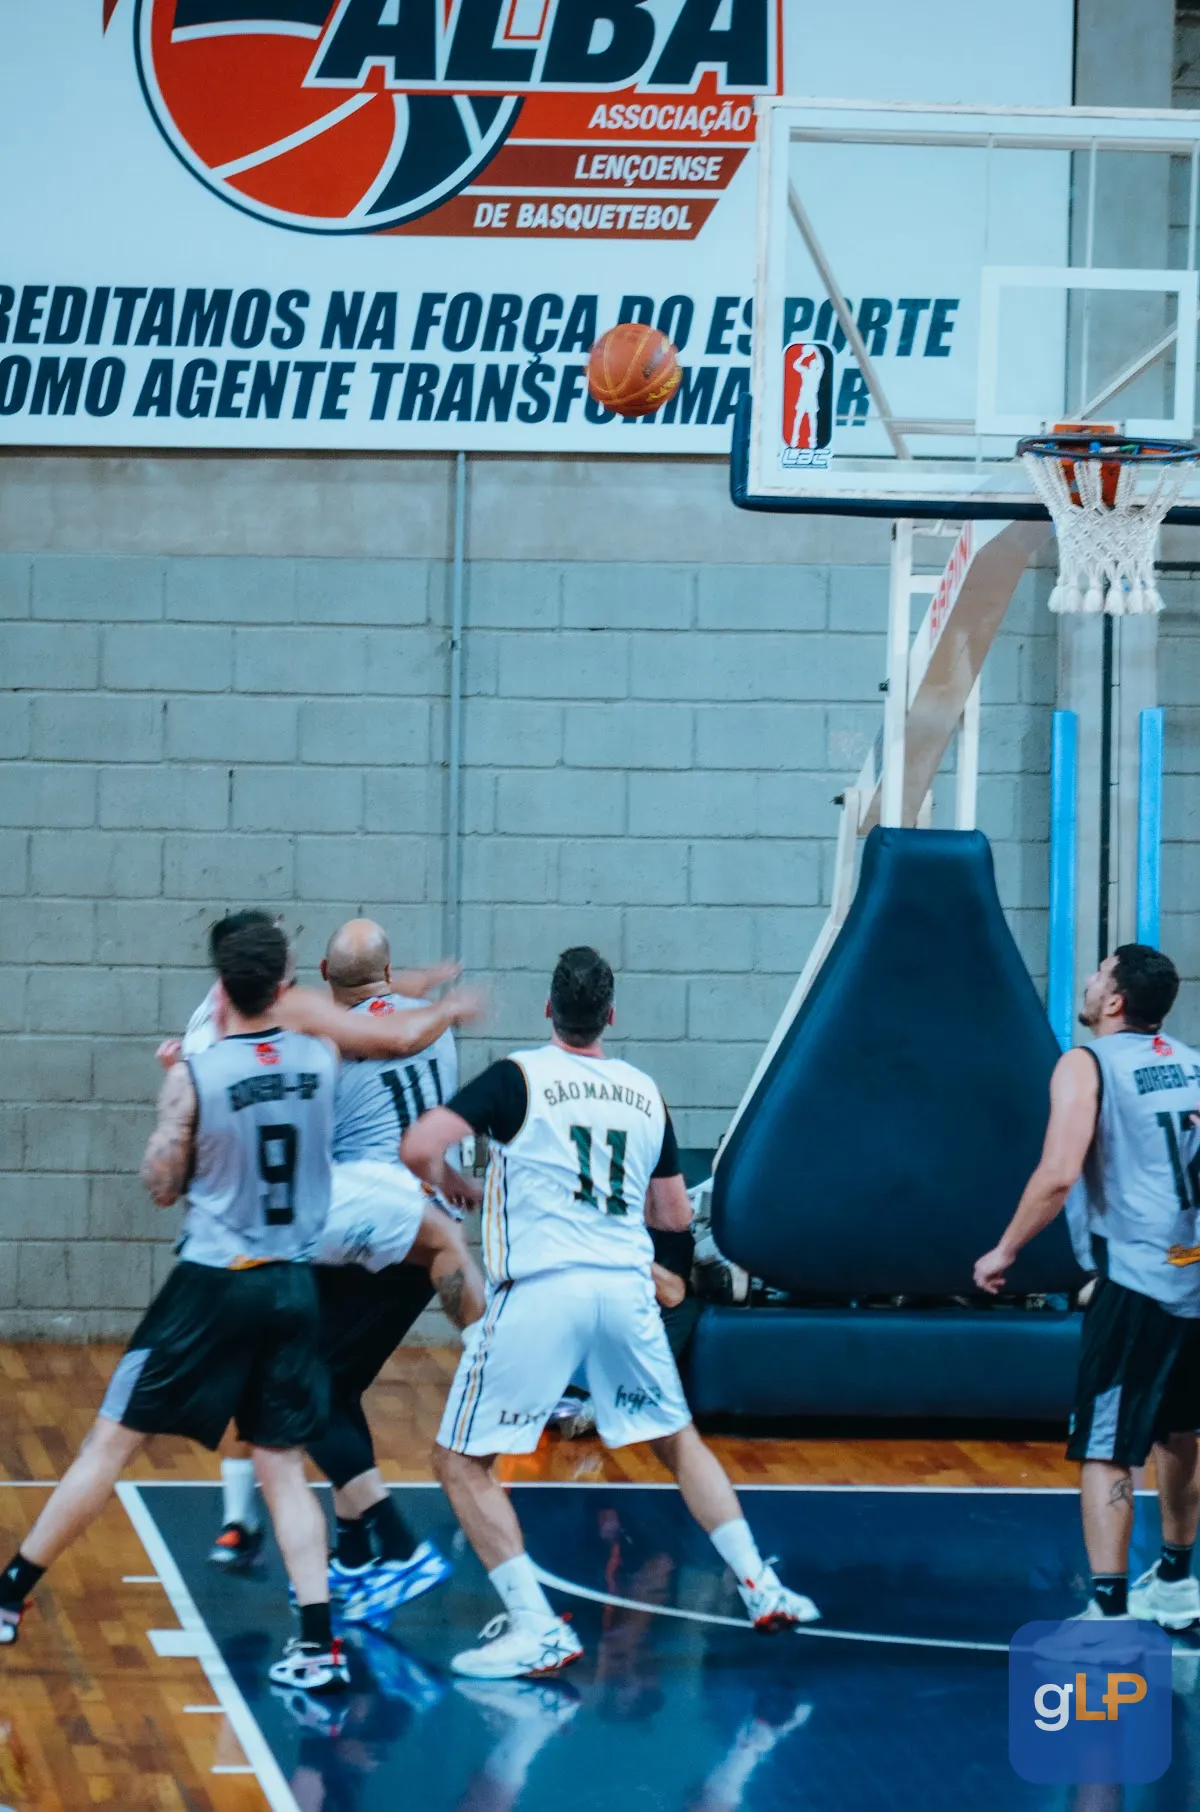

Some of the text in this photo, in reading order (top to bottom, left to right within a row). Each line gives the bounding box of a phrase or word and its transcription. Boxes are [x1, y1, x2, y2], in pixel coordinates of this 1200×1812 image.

[587, 101, 751, 138] ASSOCIAÇÃO
[574, 153, 723, 187] LENÇOENSE
[473, 202, 693, 232] DE BASQUETEBOL
[320, 290, 398, 350] NA
[410, 291, 599, 365] FORÇA
[132, 357, 356, 420] AGENTE
[544, 1080, 653, 1119] SÃO MANUEL
[257, 1123, 297, 1227] 9
[569, 1124, 629, 1217] 11
